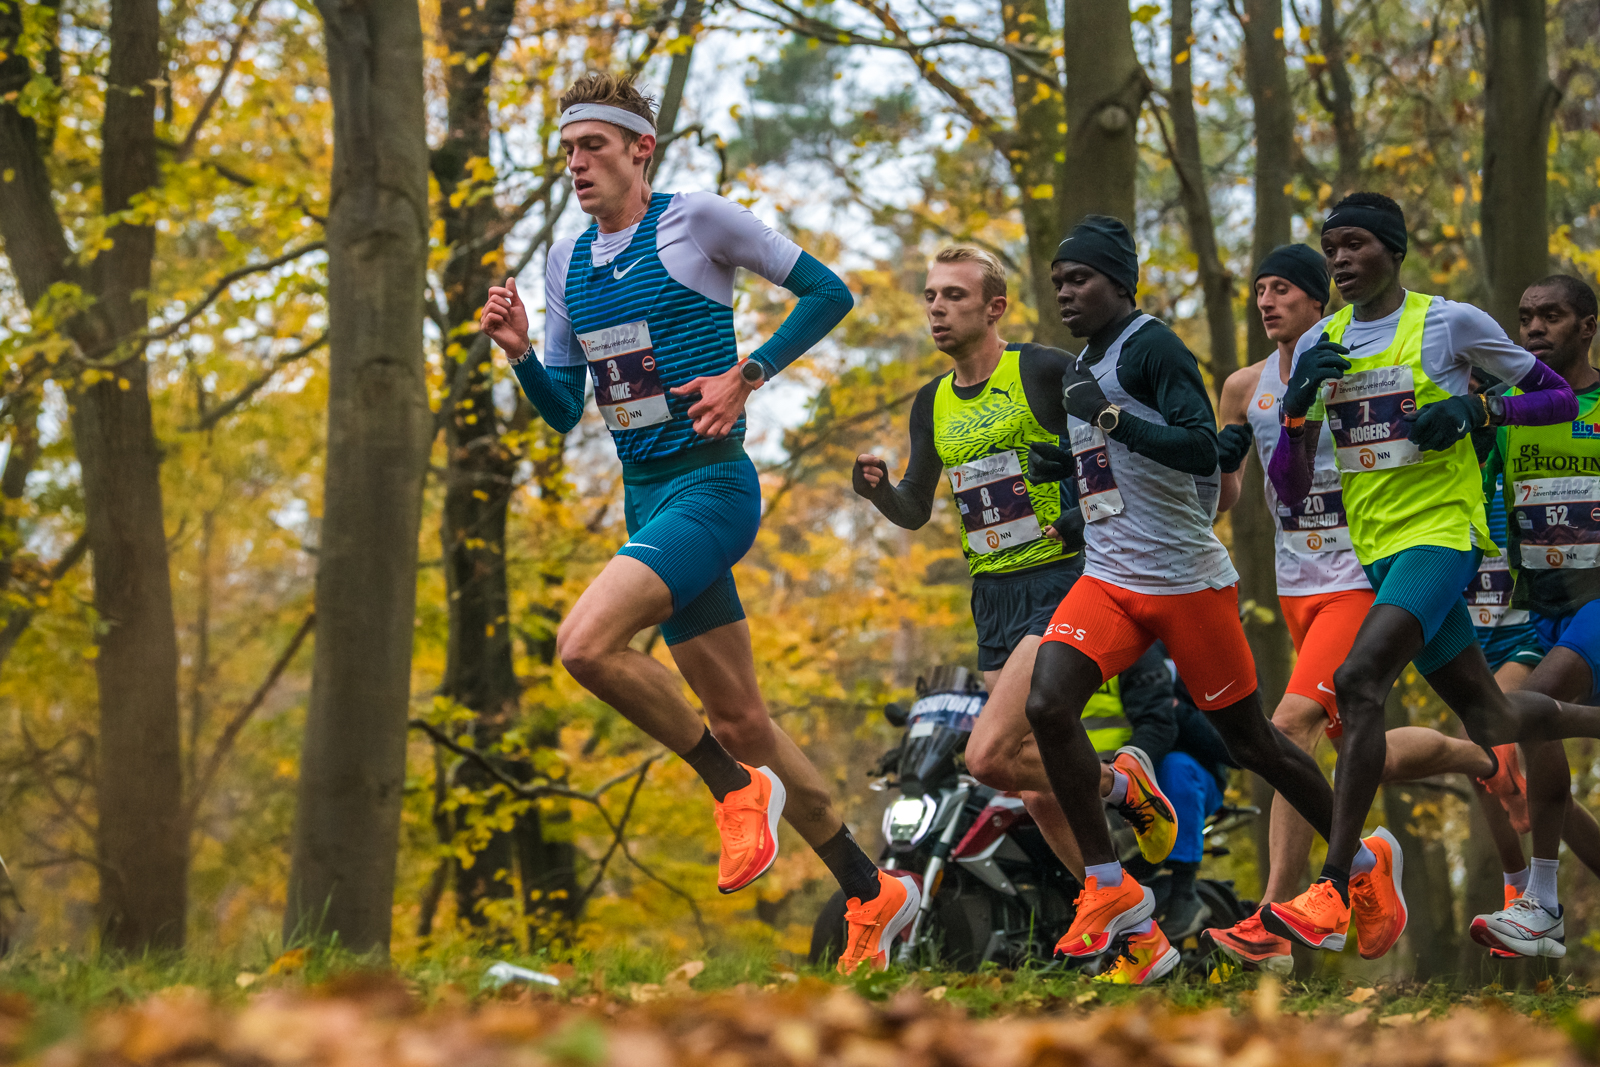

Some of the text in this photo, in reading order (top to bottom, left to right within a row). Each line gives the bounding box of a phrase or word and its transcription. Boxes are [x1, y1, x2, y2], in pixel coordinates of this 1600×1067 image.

[602, 324, 640, 355] 2022
[607, 359, 620, 381] 3
[609, 382, 631, 401] MIKE
[1339, 380, 1396, 394] Zevenheuvelenloop
[1357, 370, 1400, 396] 2022
[629, 410, 642, 419] NN
[1360, 401, 1369, 422] 7
[1350, 422, 1390, 443] ROGERS
[1376, 451, 1390, 460] NN
[1520, 444, 1539, 462] gs
[980, 487, 991, 507] 8
[1533, 489, 1588, 497] Zevenheuvelenloop
[1303, 495, 1325, 514] 20
[982, 507, 1000, 525] NILS
[1298, 512, 1339, 528] RICHARD
[1546, 505, 1570, 526] 52
[1000, 532, 1011, 540] NN
[1481, 572, 1491, 590] 6
